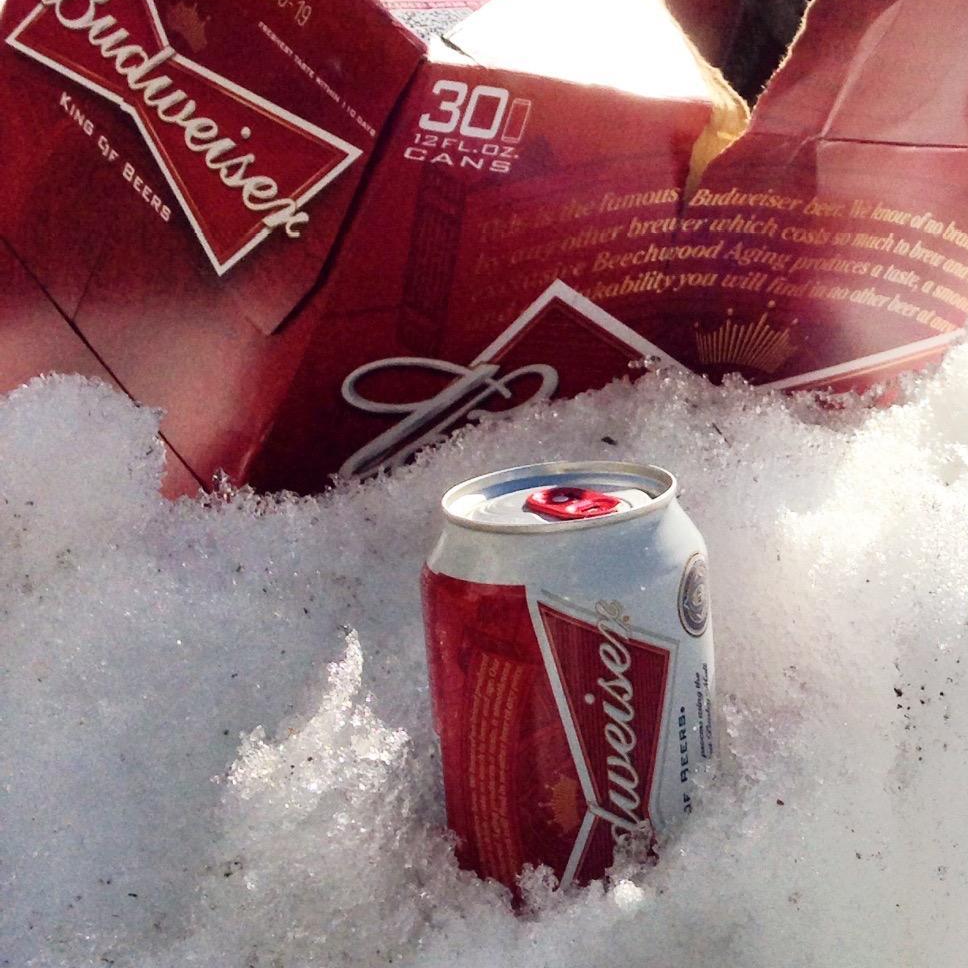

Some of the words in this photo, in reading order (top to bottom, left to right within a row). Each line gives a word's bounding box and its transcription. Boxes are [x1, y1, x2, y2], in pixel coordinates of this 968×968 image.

[418, 79, 510, 140] 30
[60, 92, 95, 137] KING
[97, 135, 120, 163] OF
[122, 162, 172, 222] BEERS
[403, 146, 512, 174] CANS
[599, 186, 682, 214] famous
[688, 187, 804, 211] Budweiser
[592, 240, 725, 273] Beechwood
[727, 241, 793, 272] Aging
[788, 253, 871, 275] produces
[709, 213, 779, 238] which
[781, 226, 829, 245] costs
[850, 232, 895, 252] much
[893, 238, 911, 257] to
[908, 240, 947, 267] brew
[672, 272, 719, 292] you
[721, 271, 768, 292] will
